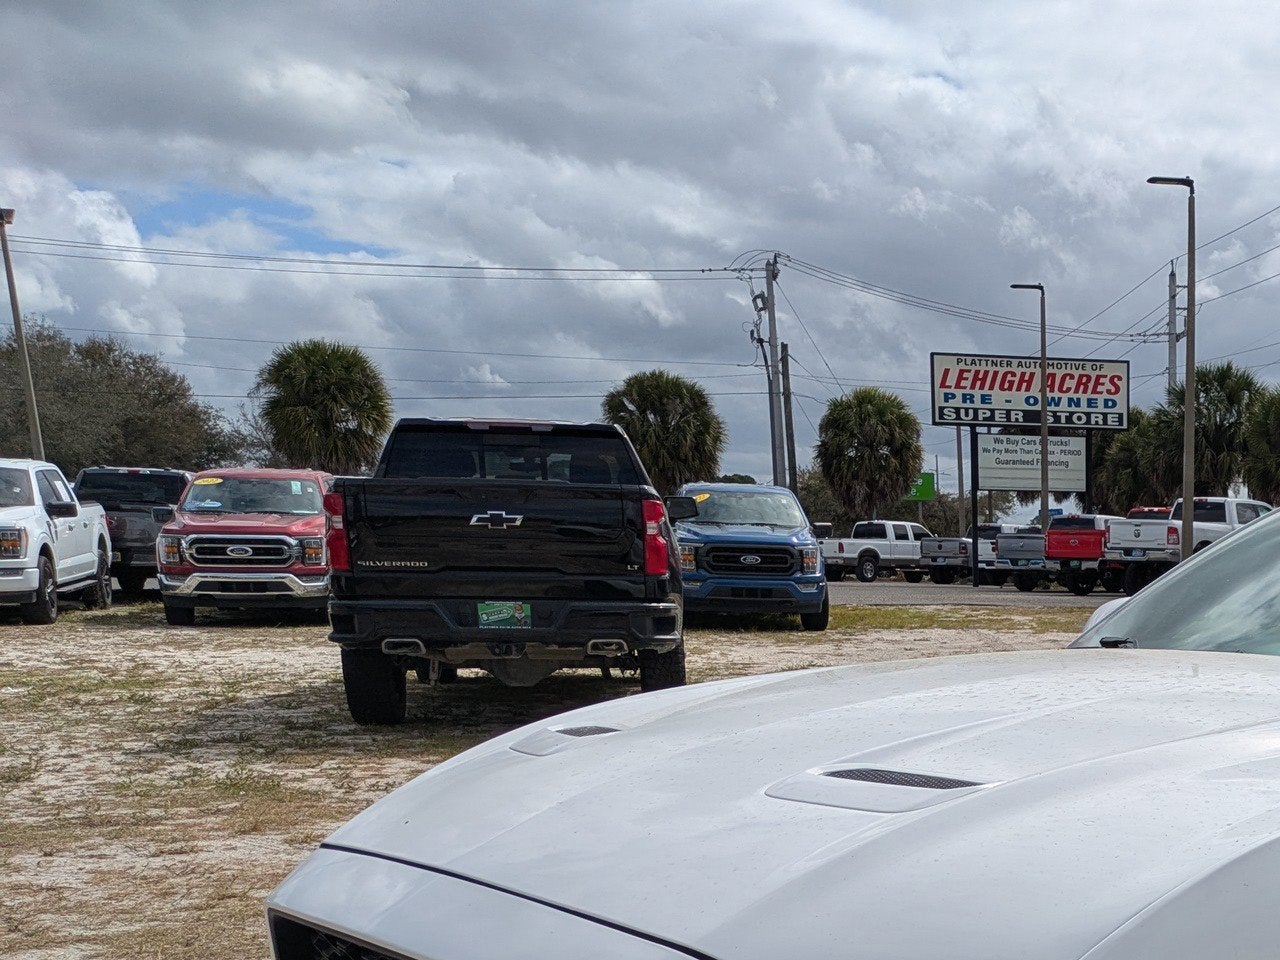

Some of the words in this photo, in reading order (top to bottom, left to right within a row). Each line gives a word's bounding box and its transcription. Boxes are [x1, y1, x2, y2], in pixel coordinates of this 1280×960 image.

[956, 357, 1013, 368] PLATTNER
[1091, 363, 1104, 371] OF
[939, 368, 1035, 392] LEHIGH
[1038, 372, 1123, 395] ACRES
[943, 408, 1024, 422] SUPER
[1046, 412, 1120, 426] STORE
[992, 437, 1005, 445] We
[1006, 437, 1020, 447] Buy
[1020, 438, 1037, 446] Cars
[992, 447, 1003, 455] Pay
[1059, 449, 1082, 457] PERIOD
[995, 457, 1034, 466] Guaranteed
[1036, 458, 1069, 469] Fancing
